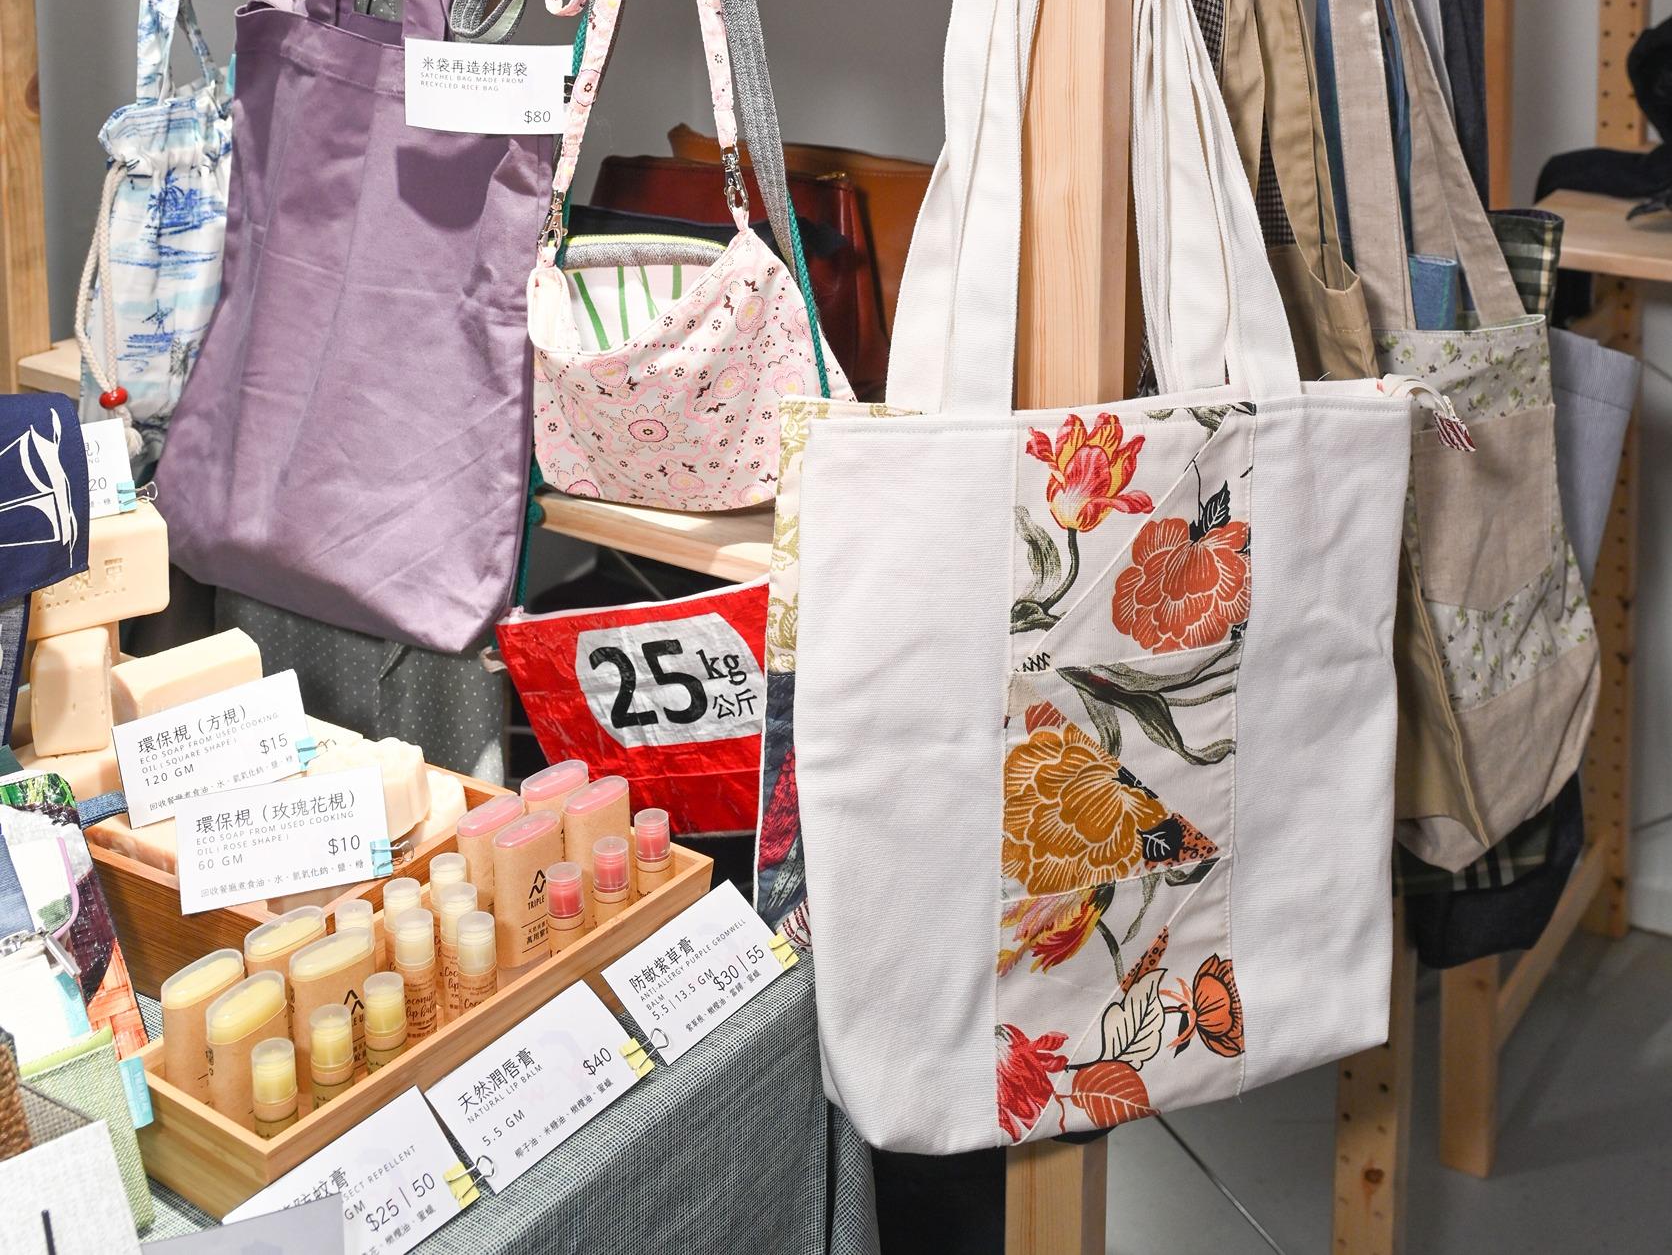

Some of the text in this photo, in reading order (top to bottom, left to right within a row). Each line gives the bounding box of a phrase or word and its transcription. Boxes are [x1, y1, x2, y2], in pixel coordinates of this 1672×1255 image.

[420, 72, 453, 81] SATCHEL
[422, 56, 528, 76] 米袋再造斜揹袋
[420, 81, 458, 89] RECYCLED
[524, 110, 551, 124] $80
[588, 639, 747, 729] 25 kg
[712, 688, 757, 720] 公斤
[140, 712, 279, 764] ECO SOAP FROM USED COOKING
[260, 733, 288, 755] $15
[141, 764, 158, 774] OIL
[145, 764, 194, 787] 120 GM
[196, 811, 354, 846] ECO SOAP FROM USED COOKING
[197, 846, 213, 856] OIL
[328, 835, 361, 856] $10
[198, 853, 243, 871] 60 GM
[527, 896, 545, 911] TRIPLE
[628, 936, 695, 994] 防敏紫草膏
[640, 918, 747, 1002] ANTI-ALLERGY PURPLE GROMWELL
[712, 963, 740, 992] $30
[746, 944, 765, 965] 55
[646, 993, 665, 1011] BALM
[652, 1004, 670, 1021] 5.5
[674, 983, 697, 1003] 13.5
[697, 968, 715, 986] GM
[582, 1047, 612, 1076] $40
[457, 1047, 535, 1115] 天然潤唇膏
[467, 1064, 543, 1124] NATURAL LIP BALM
[482, 1108, 526, 1147] 5.5 GM
[367, 1144, 417, 1184] REPELLENT
[344, 1200, 366, 1220] GM
[366, 1198, 399, 1232] $25
[412, 1173, 435, 1198] 50
